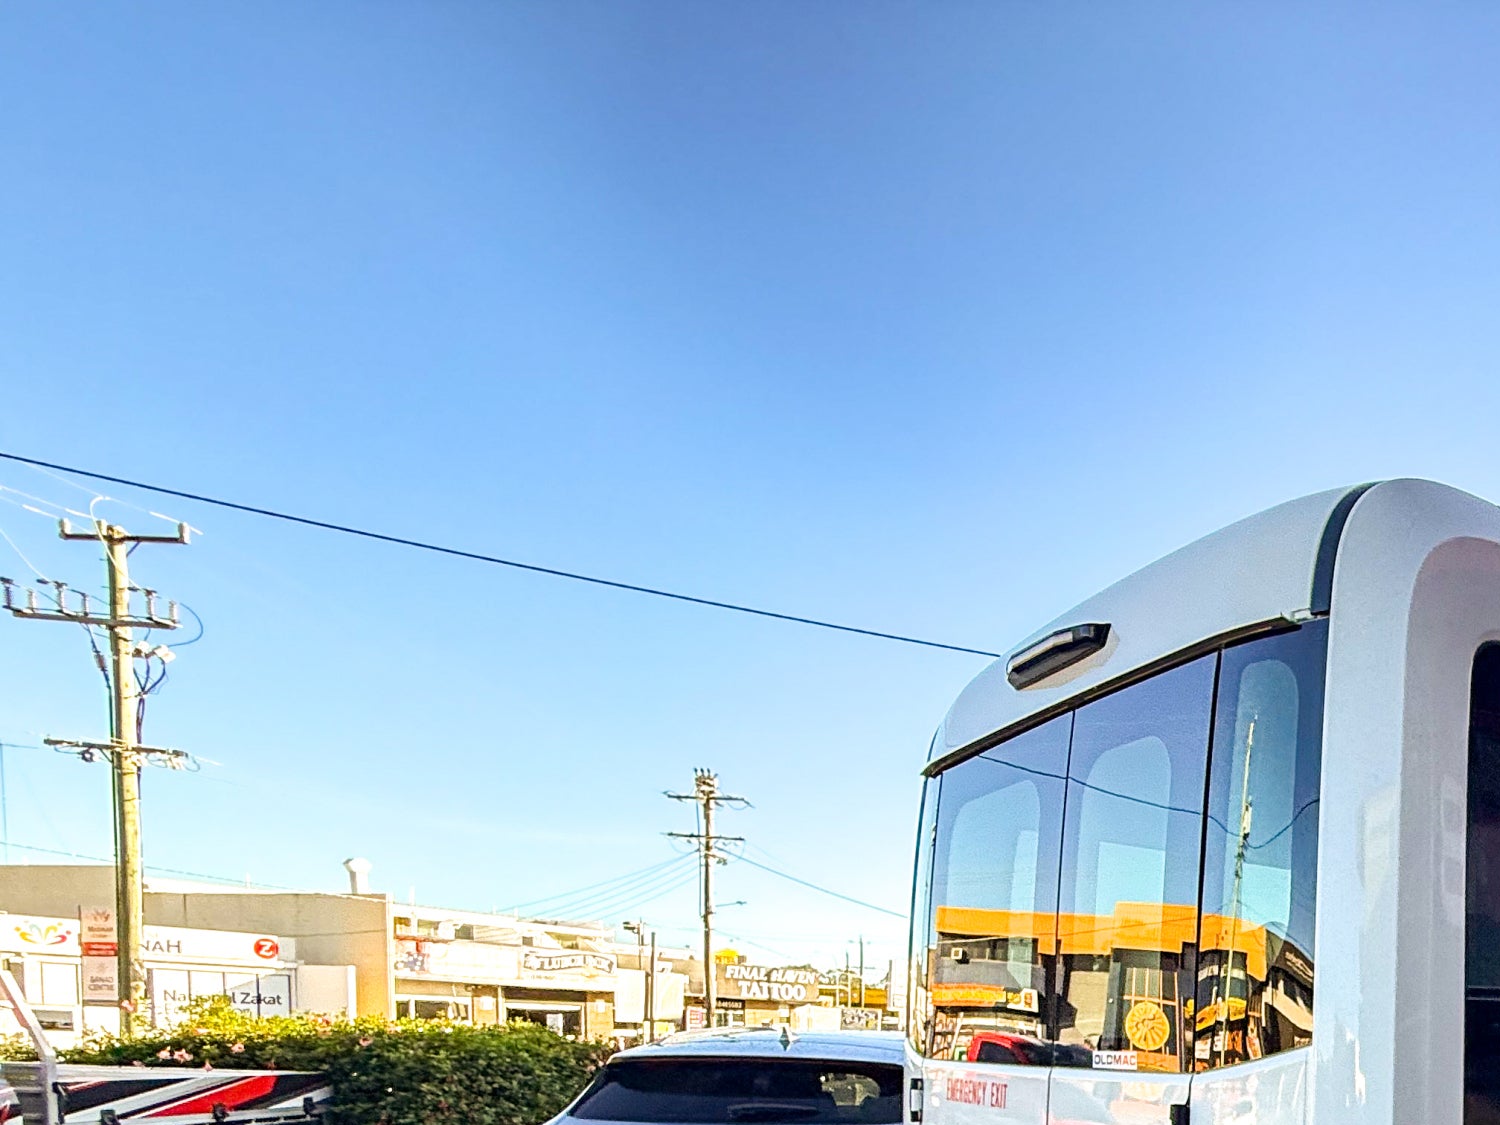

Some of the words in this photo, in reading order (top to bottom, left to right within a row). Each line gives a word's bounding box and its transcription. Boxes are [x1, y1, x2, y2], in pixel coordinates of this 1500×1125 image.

[726, 965, 767, 982] FINAL
[769, 969, 815, 985] HAVEN
[240, 992, 282, 1005] Zakat
[738, 981, 807, 1000] TATTOO
[1094, 1054, 1136, 1066] OLDMAC
[947, 1078, 987, 1105] EMERGENCY
[991, 1082, 1008, 1109] EXIT
